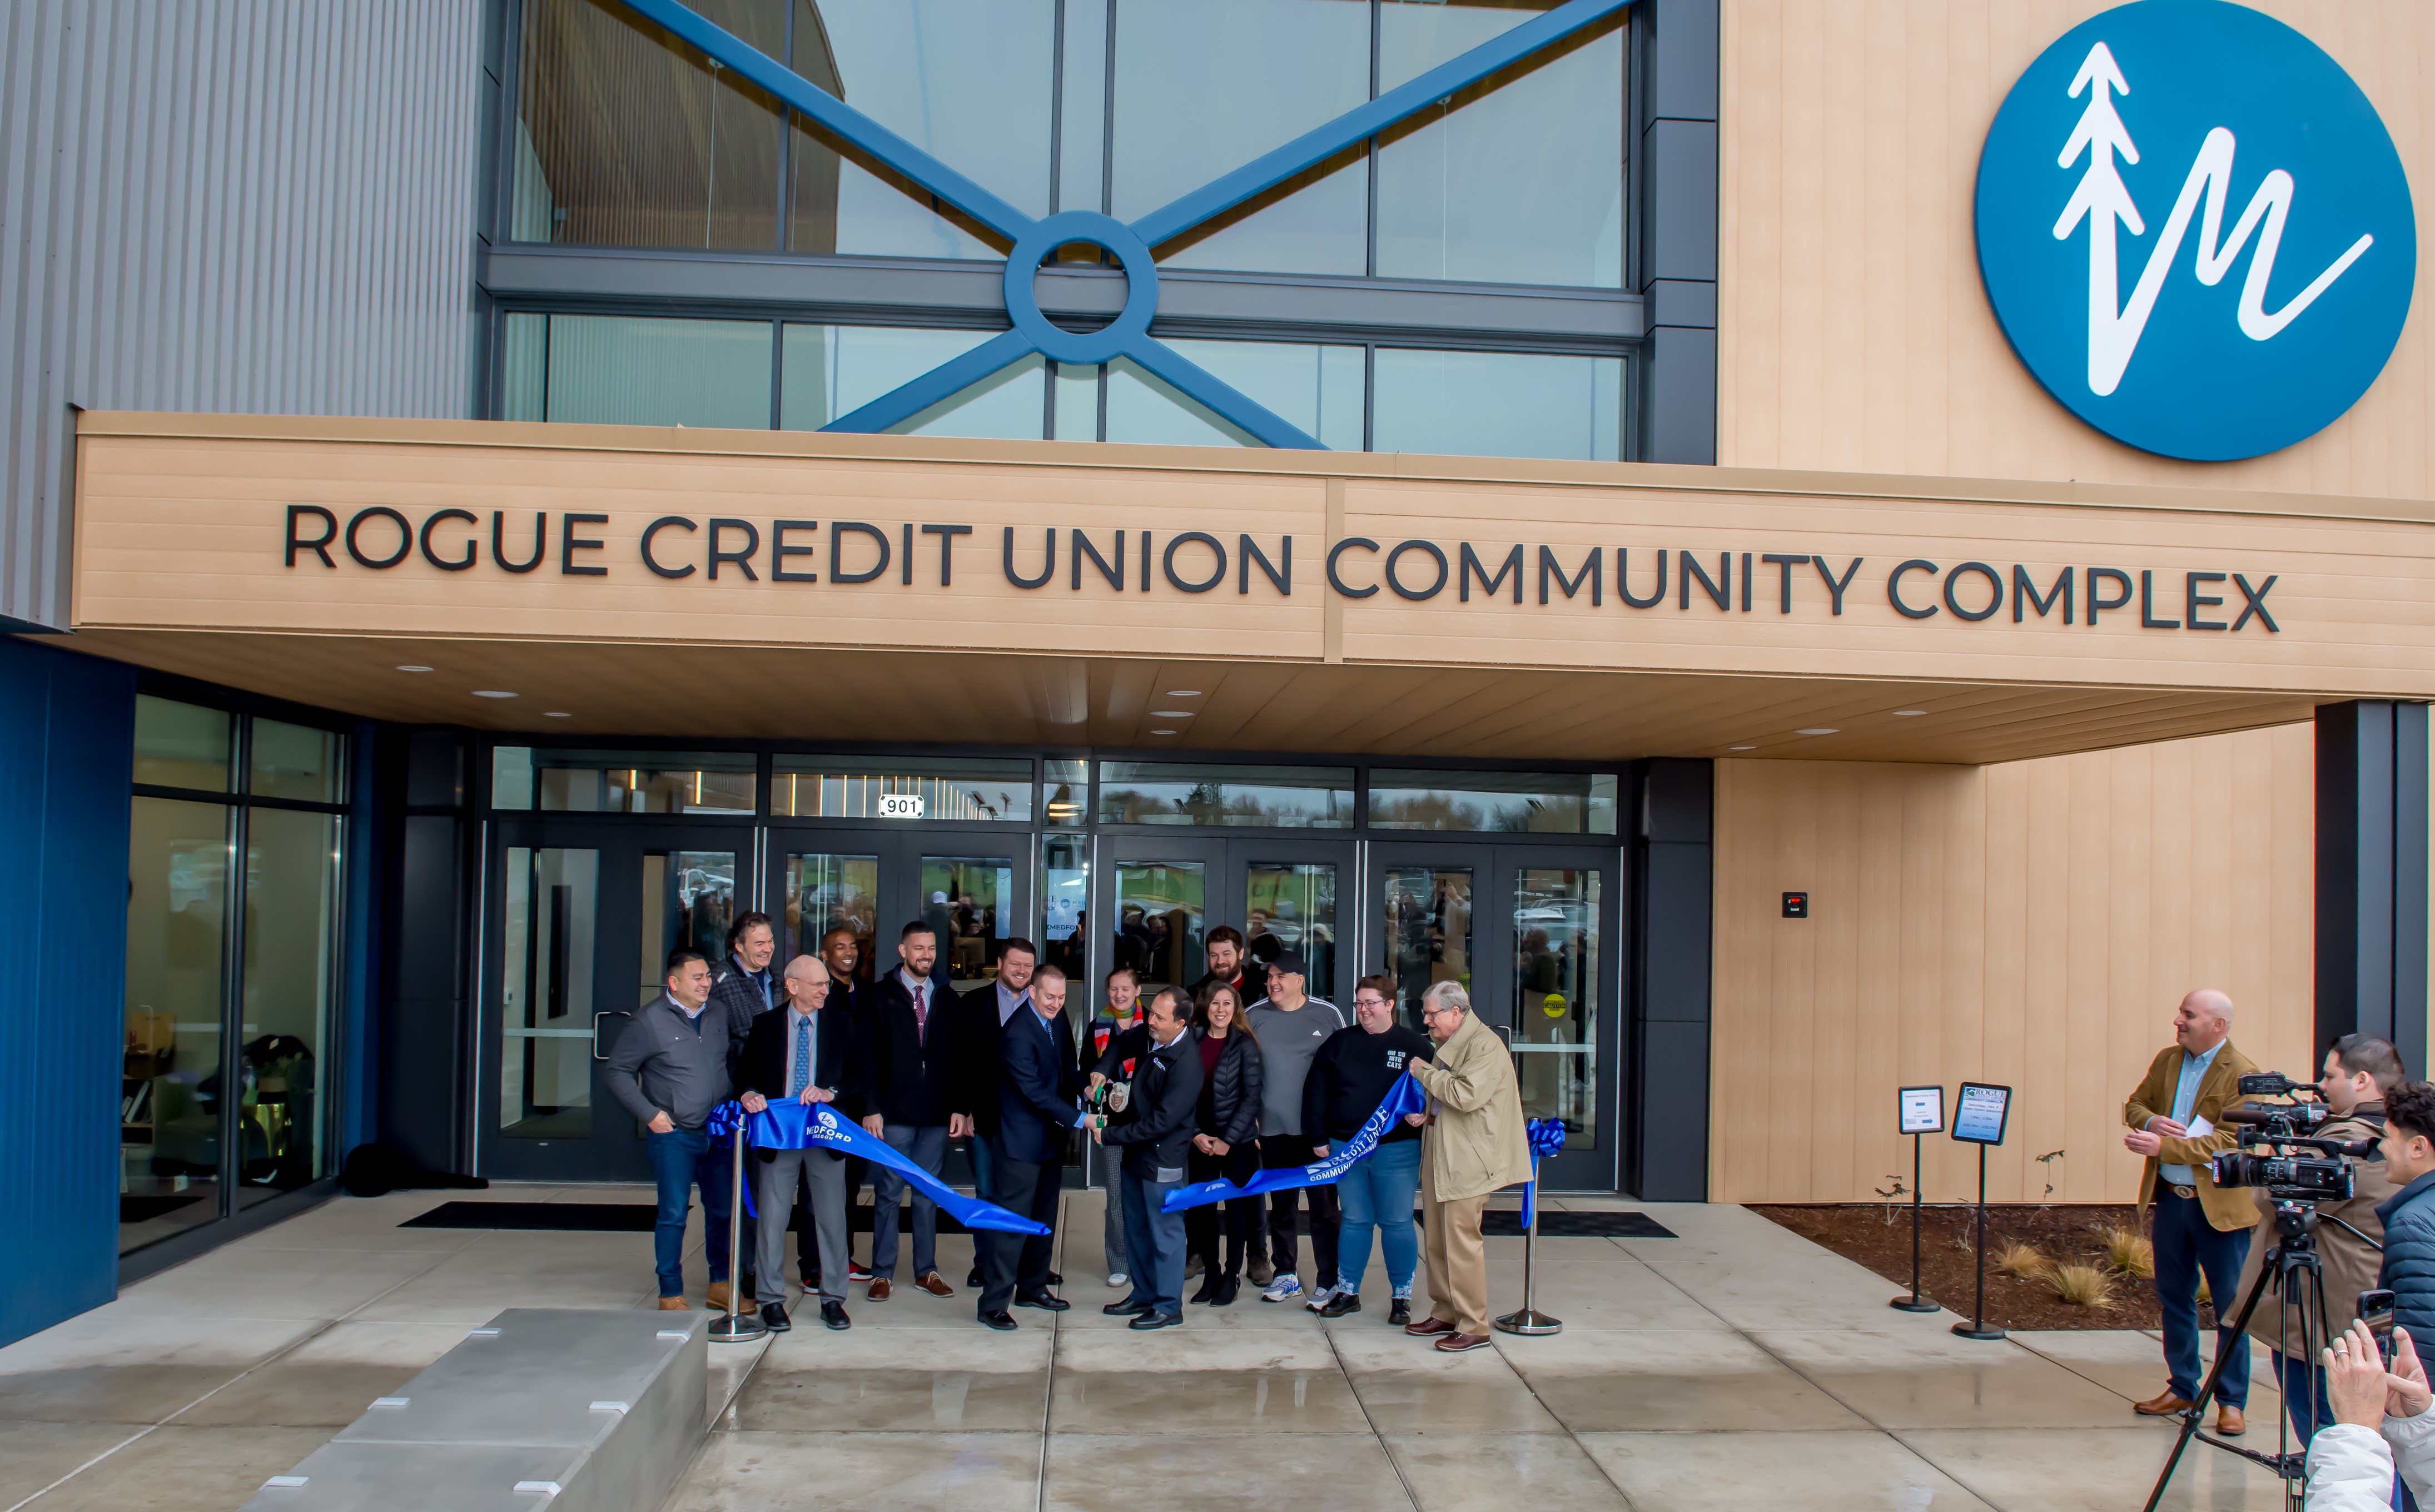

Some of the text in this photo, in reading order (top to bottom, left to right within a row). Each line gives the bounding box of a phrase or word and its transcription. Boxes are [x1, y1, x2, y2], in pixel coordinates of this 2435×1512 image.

[284, 505, 2280, 634] ROGUE CREDIT UNION COMMUNITY COMPLEX
[887, 799, 916, 813] 901
[1976, 1088, 2006, 1097] ROGUE
[806, 1125, 852, 1142] MEDFORD
